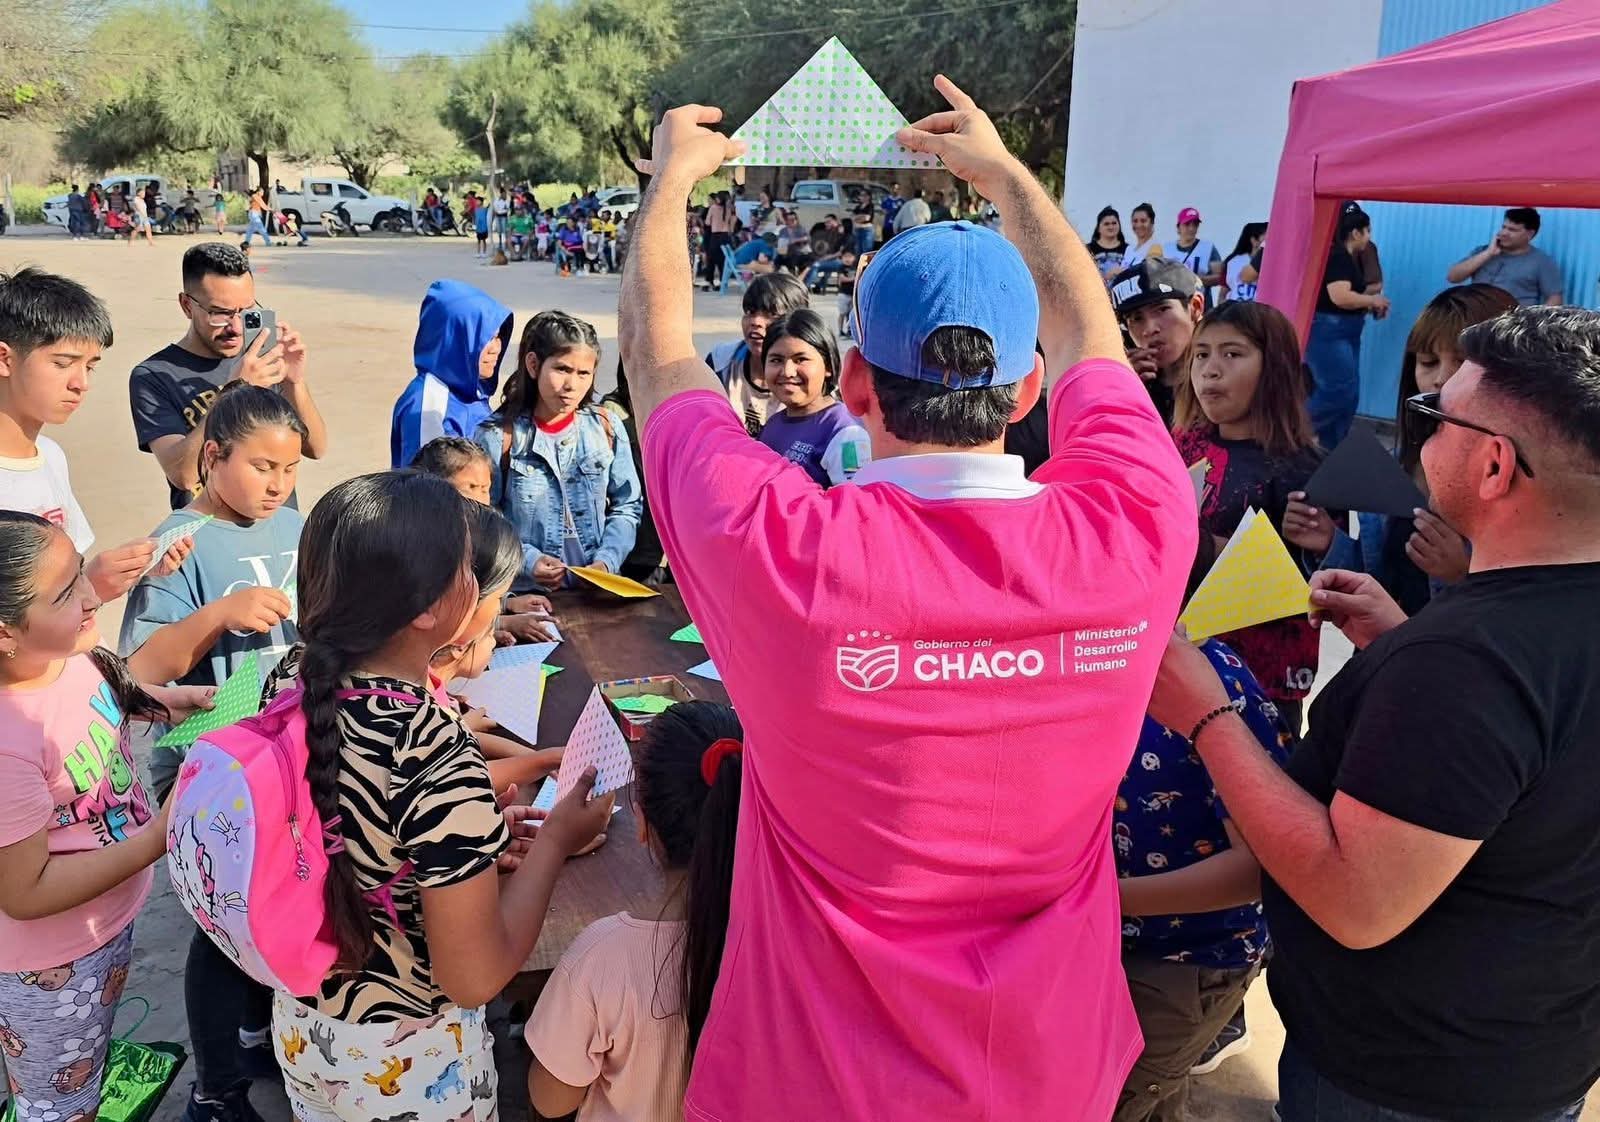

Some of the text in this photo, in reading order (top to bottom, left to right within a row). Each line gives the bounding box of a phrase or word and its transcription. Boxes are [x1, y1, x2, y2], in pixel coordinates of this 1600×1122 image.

[1074, 624, 1138, 641] Ministerio
[913, 638, 992, 650] Gobierno del
[1074, 640, 1137, 657] Desarrollo
[913, 648, 1045, 682] CHACO
[1074, 658, 1127, 673] Humano
[64, 680, 122, 795] HAV
